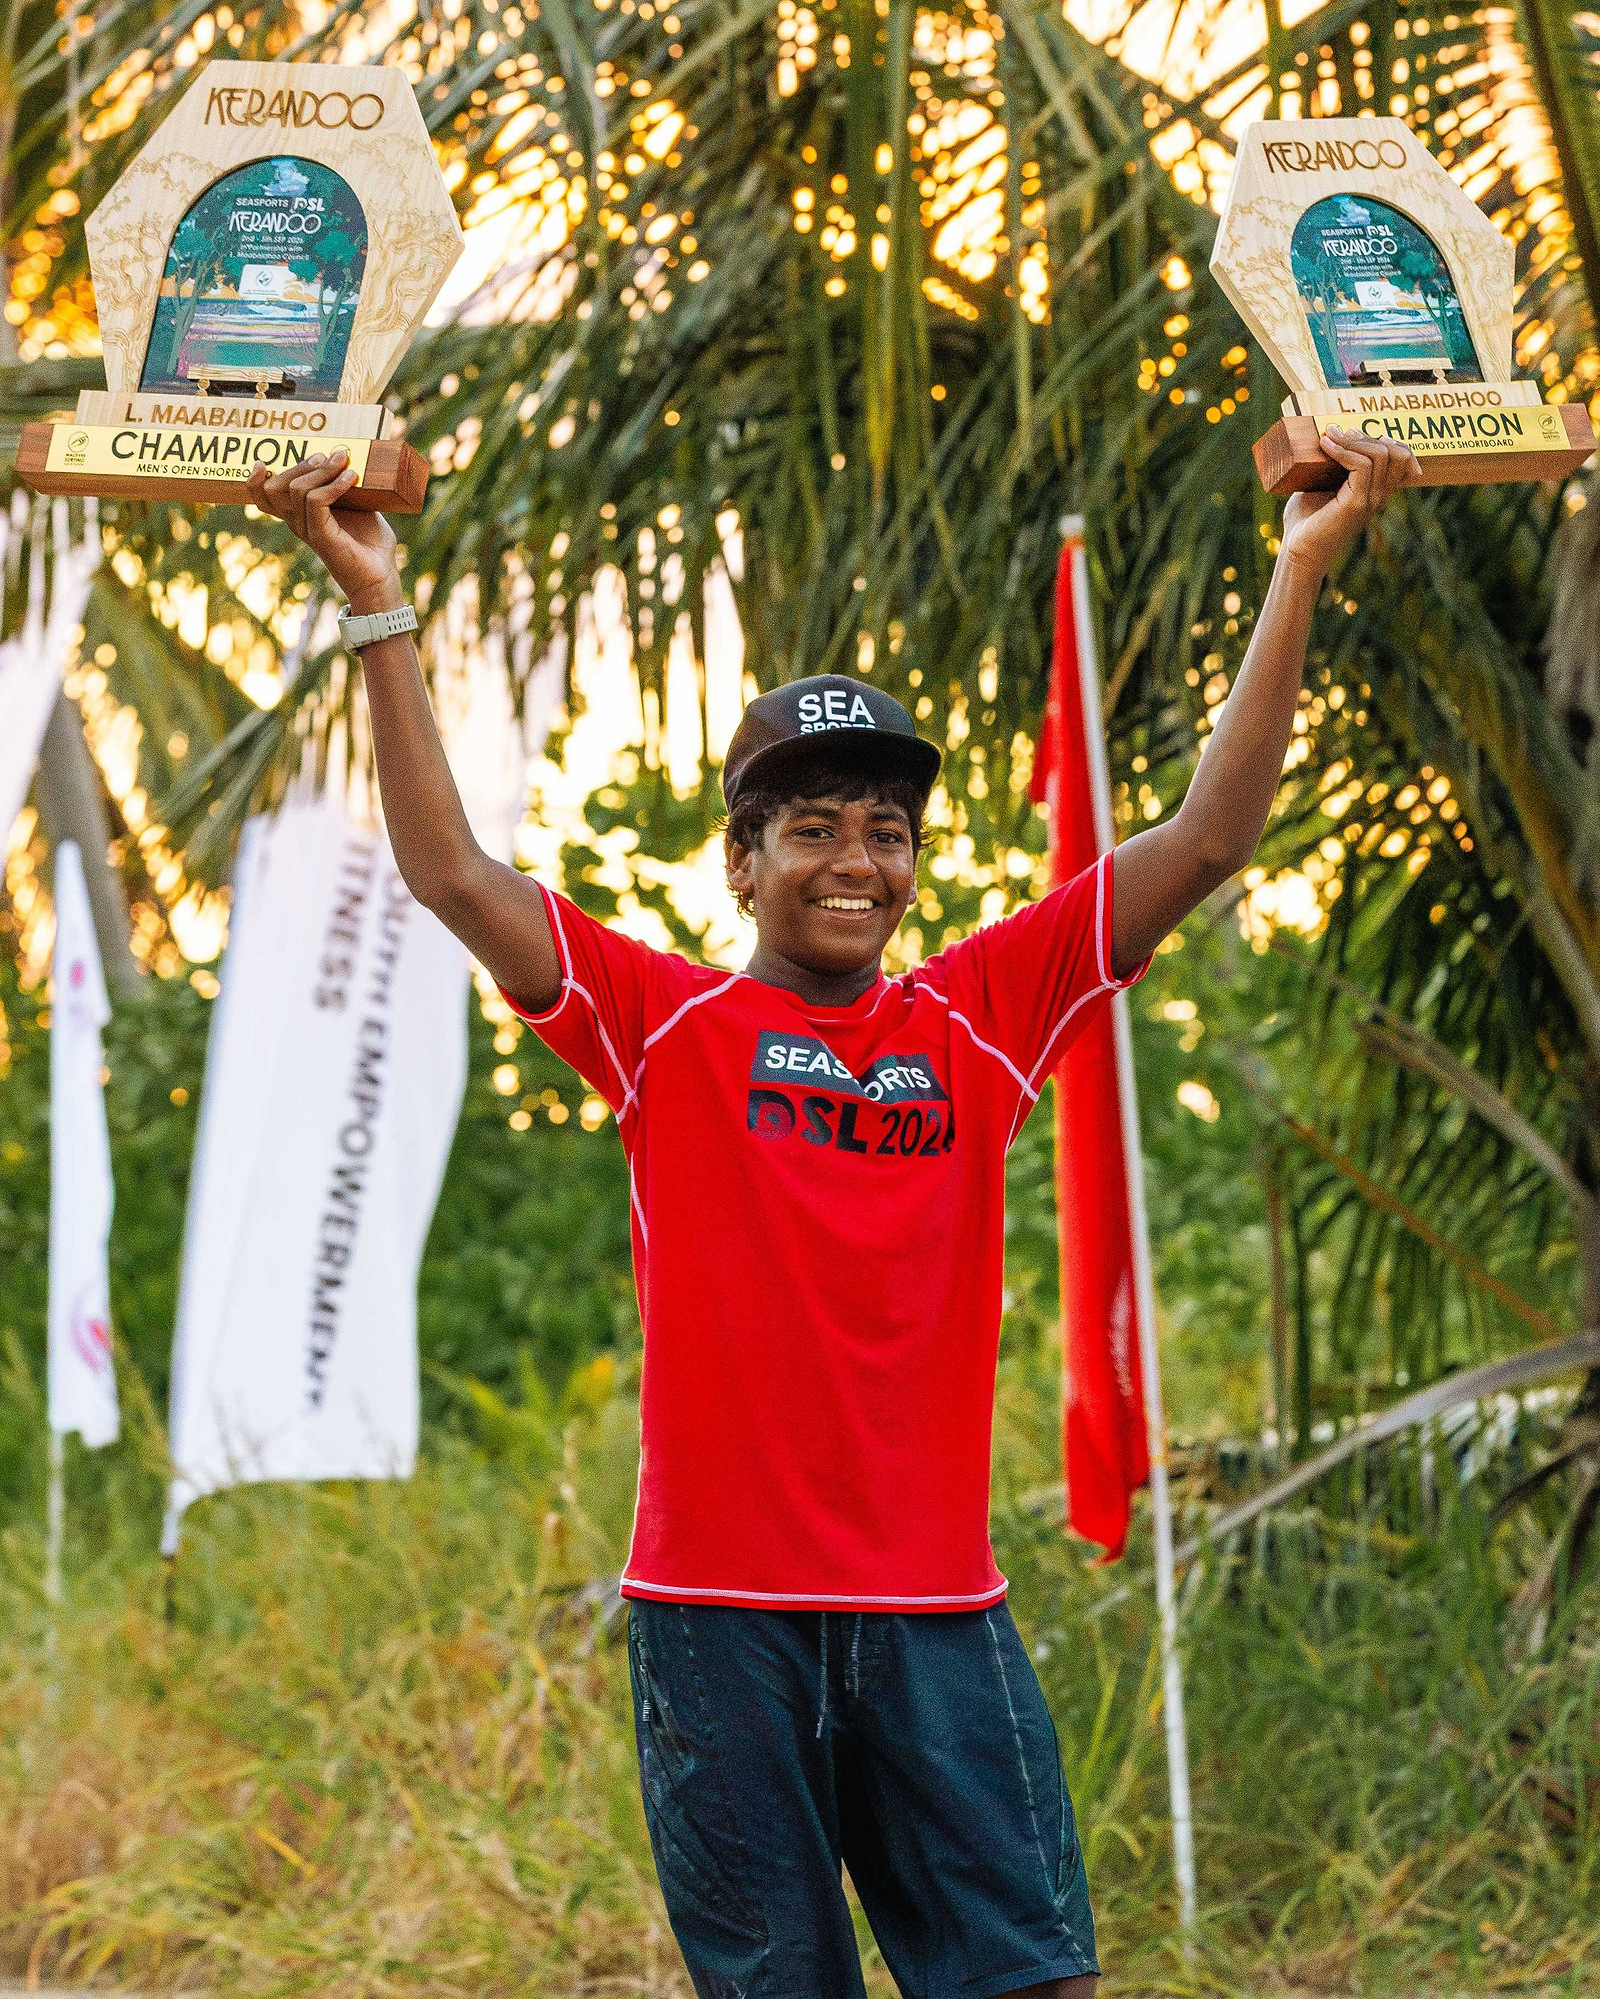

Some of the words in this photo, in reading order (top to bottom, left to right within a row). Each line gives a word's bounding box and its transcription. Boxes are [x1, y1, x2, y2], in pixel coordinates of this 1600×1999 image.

[204, 87, 385, 131] KERANDOO
[1262, 139, 1407, 174] KERANDOO
[235, 197, 289, 208] SEASPORTS
[228, 210, 322, 235] KERANDOO
[1322, 237, 1398, 257] KERANDOO
[124, 402, 143, 424] L.
[151, 404, 328, 432] MAABAIDHOO
[1337, 397, 1356, 414] L.
[1359, 391, 1502, 414] MAABAIDHOO
[1361, 412, 1524, 441] CHAMPION
[111, 430, 309, 468] CHAMPION
[1409, 442, 1431, 451] NIOR
[1433, 441, 1456, 450] BOYS
[1457, 438, 1514, 449] SHORTBOARD
[136, 463, 168, 475] MEN'S
[171, 465, 200, 476] OPEN
[798, 690, 876, 724] SEA
[310, 838, 379, 1013] ITNESS
[765, 1044, 932, 1102] SEASORTS
